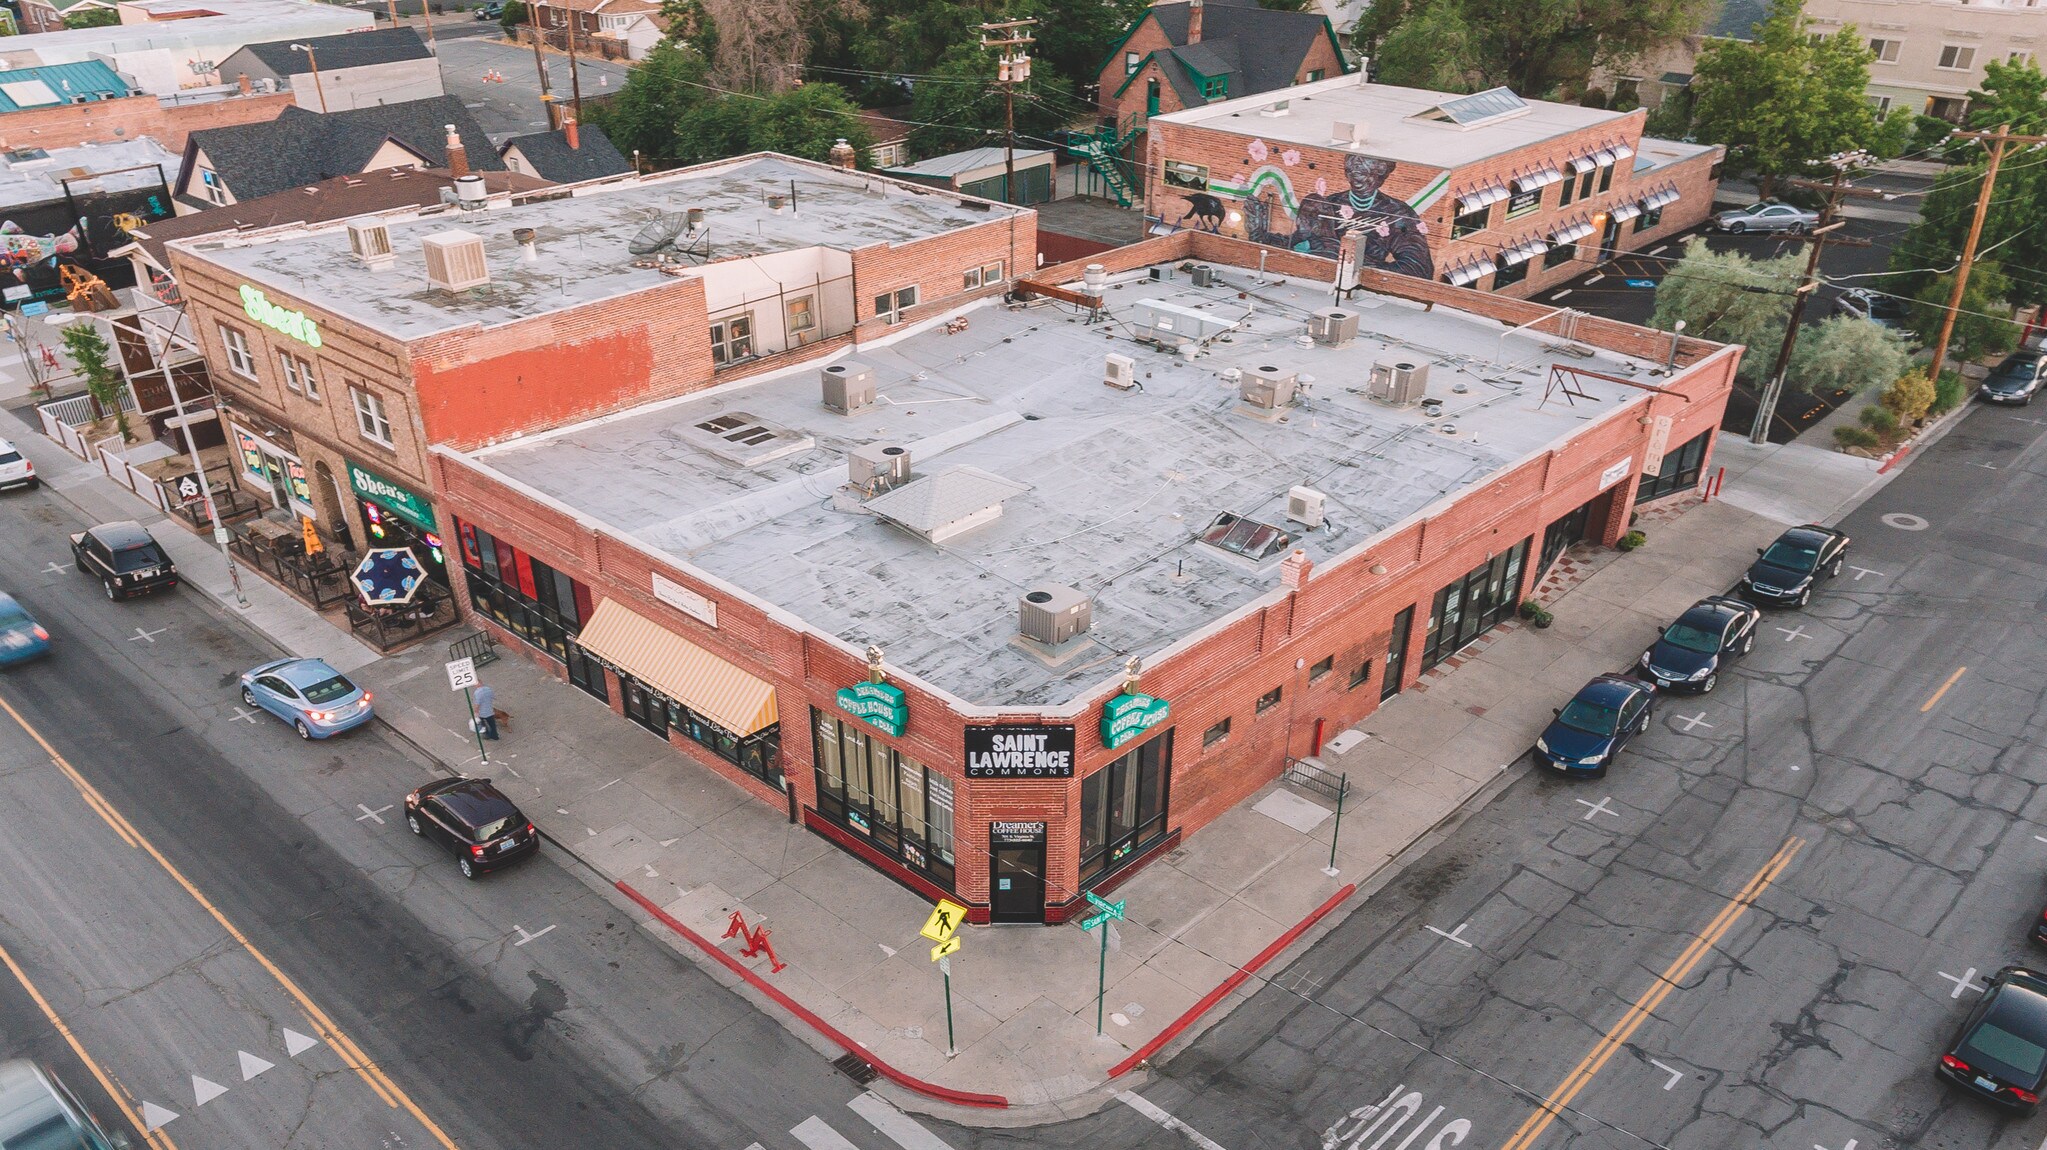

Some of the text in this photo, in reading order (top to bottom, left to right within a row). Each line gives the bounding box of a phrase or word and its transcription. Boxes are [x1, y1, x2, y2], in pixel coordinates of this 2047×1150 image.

[240, 285, 322, 347] Shea's
[353, 468, 407, 502] Shea's
[450, 661, 470, 670] SPEED
[452, 667, 469, 675] LIMIT
[454, 672, 473, 685] 25
[838, 695, 894, 720] COFFEE HOUSE
[1111, 706, 1168, 735] COFFEE HOUSE
[992, 734, 1048, 752] SAINT
[969, 751, 1070, 768] LAWRENCE
[993, 821, 1044, 829] Dreamer's
